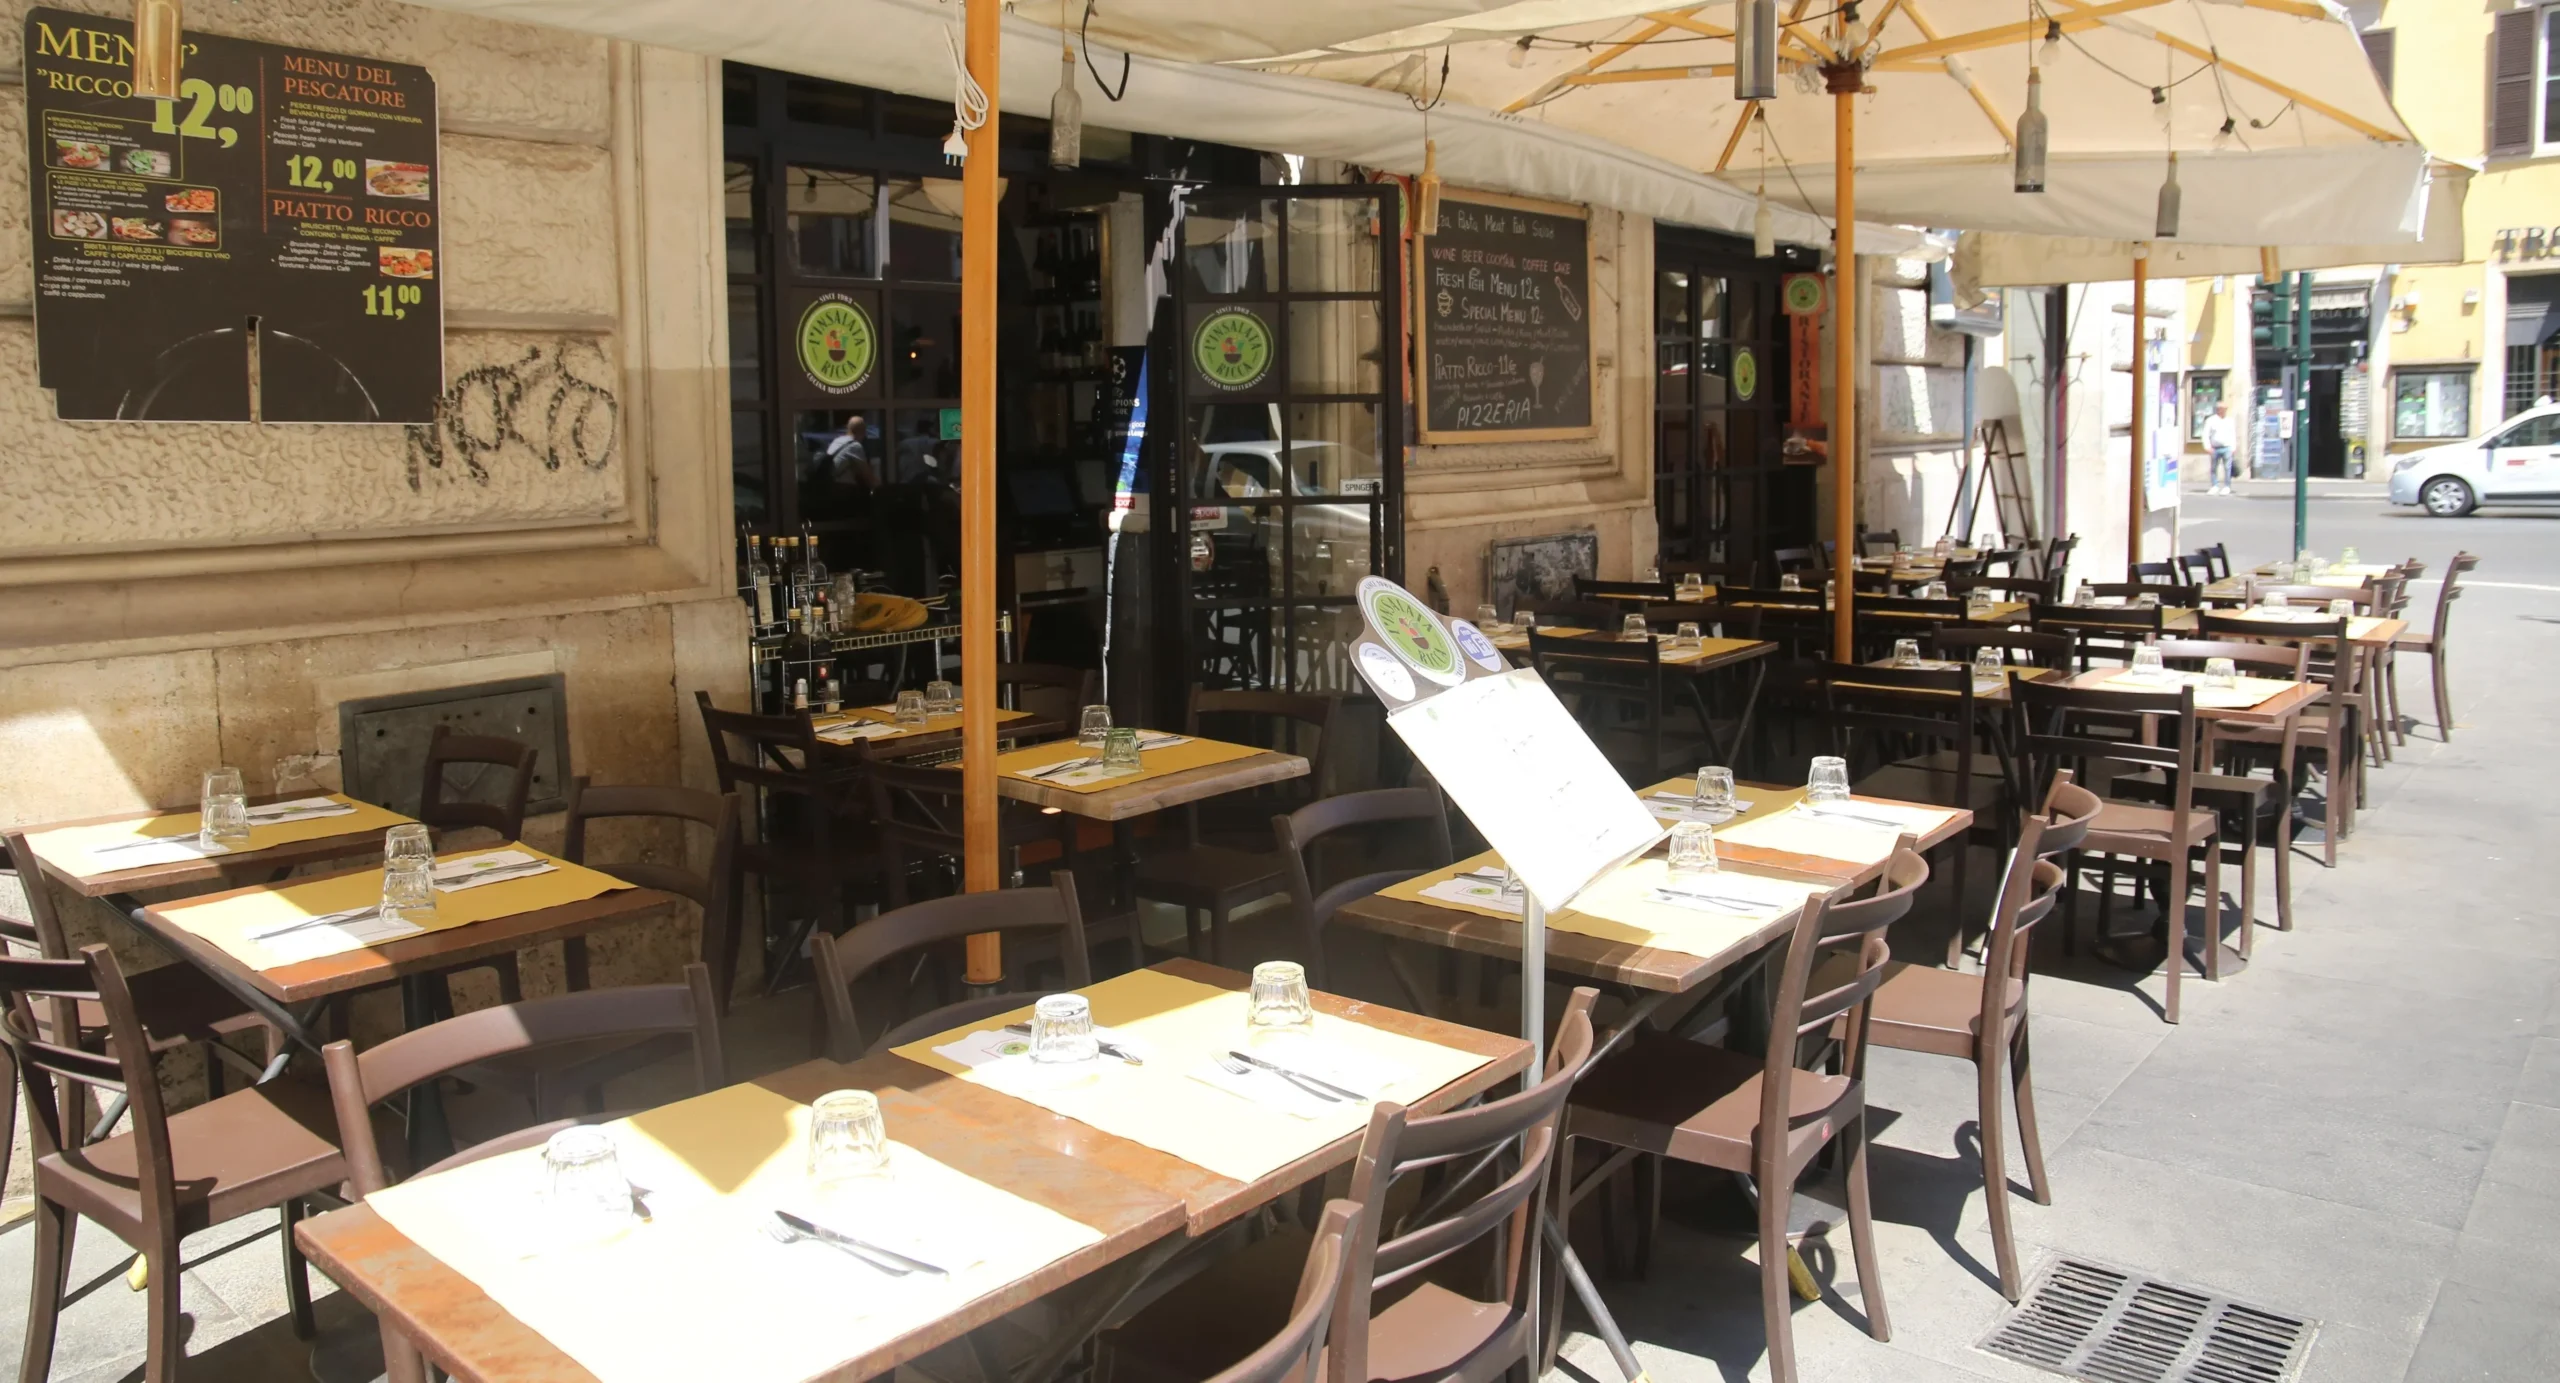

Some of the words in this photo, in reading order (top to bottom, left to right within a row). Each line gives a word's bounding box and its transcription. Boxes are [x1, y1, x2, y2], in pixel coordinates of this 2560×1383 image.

[36, 21, 198, 69] MEN'
[284, 55, 349, 79] MENU
[356, 65, 397, 86] DEL
[284, 77, 406, 108] PESCATORE
[280, 116, 297, 124] Fresh
[289, 108, 319, 118] BEVANDA
[290, 101, 312, 110] PESCE
[312, 104, 339, 113] FRESCO
[348, 108, 378, 118] GIORNATA
[394, 115, 423, 124] VERDURA
[286, 154, 357, 193] 12,00
[272, 199, 353, 222] PIATTO
[365, 207, 431, 228] RICCO
[1457, 209, 1479, 232] Pasta
[1484, 213, 1505, 233] Meat
[1512, 216, 1527, 234] Fish
[300, 222, 343, 232] BRUSCHETTA
[346, 226, 368, 234] PRIMO
[372, 228, 403, 236] SECONDO
[300, 230, 336, 238] CONTORNO
[341, 232, 370, 241] BEVANDA
[53, 256, 71, 264] Drink
[84, 242, 106, 251] BIBITA
[112, 245, 134, 253] BIRRA
[166, 249, 204, 258] BICCHIERE
[214, 252, 230, 260] VINO
[116, 252, 164, 262] CAPPUCCINO
[1431, 247, 1457, 262] WINE
[1461, 249, 1484, 264] BEER
[1521, 257, 1548, 273] COFFEE
[1553, 261, 1571, 275] CAKE
[1435, 267, 1465, 289] FRESH
[1490, 272, 1517, 298] MENU
[1520, 276, 1540, 300] 12€
[362, 284, 421, 320] 11,00
[1461, 296, 1497, 321] SPECIAL
[1500, 301, 1526, 323] MENU
[820, 360, 857, 378] RICCA
[1216, 362, 1253, 378] RICCA
[1434, 353, 1465, 381] PIATTO
[806, 372, 827, 392] CUCINA
[1457, 397, 1531, 429] PIZZERIA
[1345, 483, 1380, 492] SPINGER
[1418, 647, 1447, 668] RICCA
